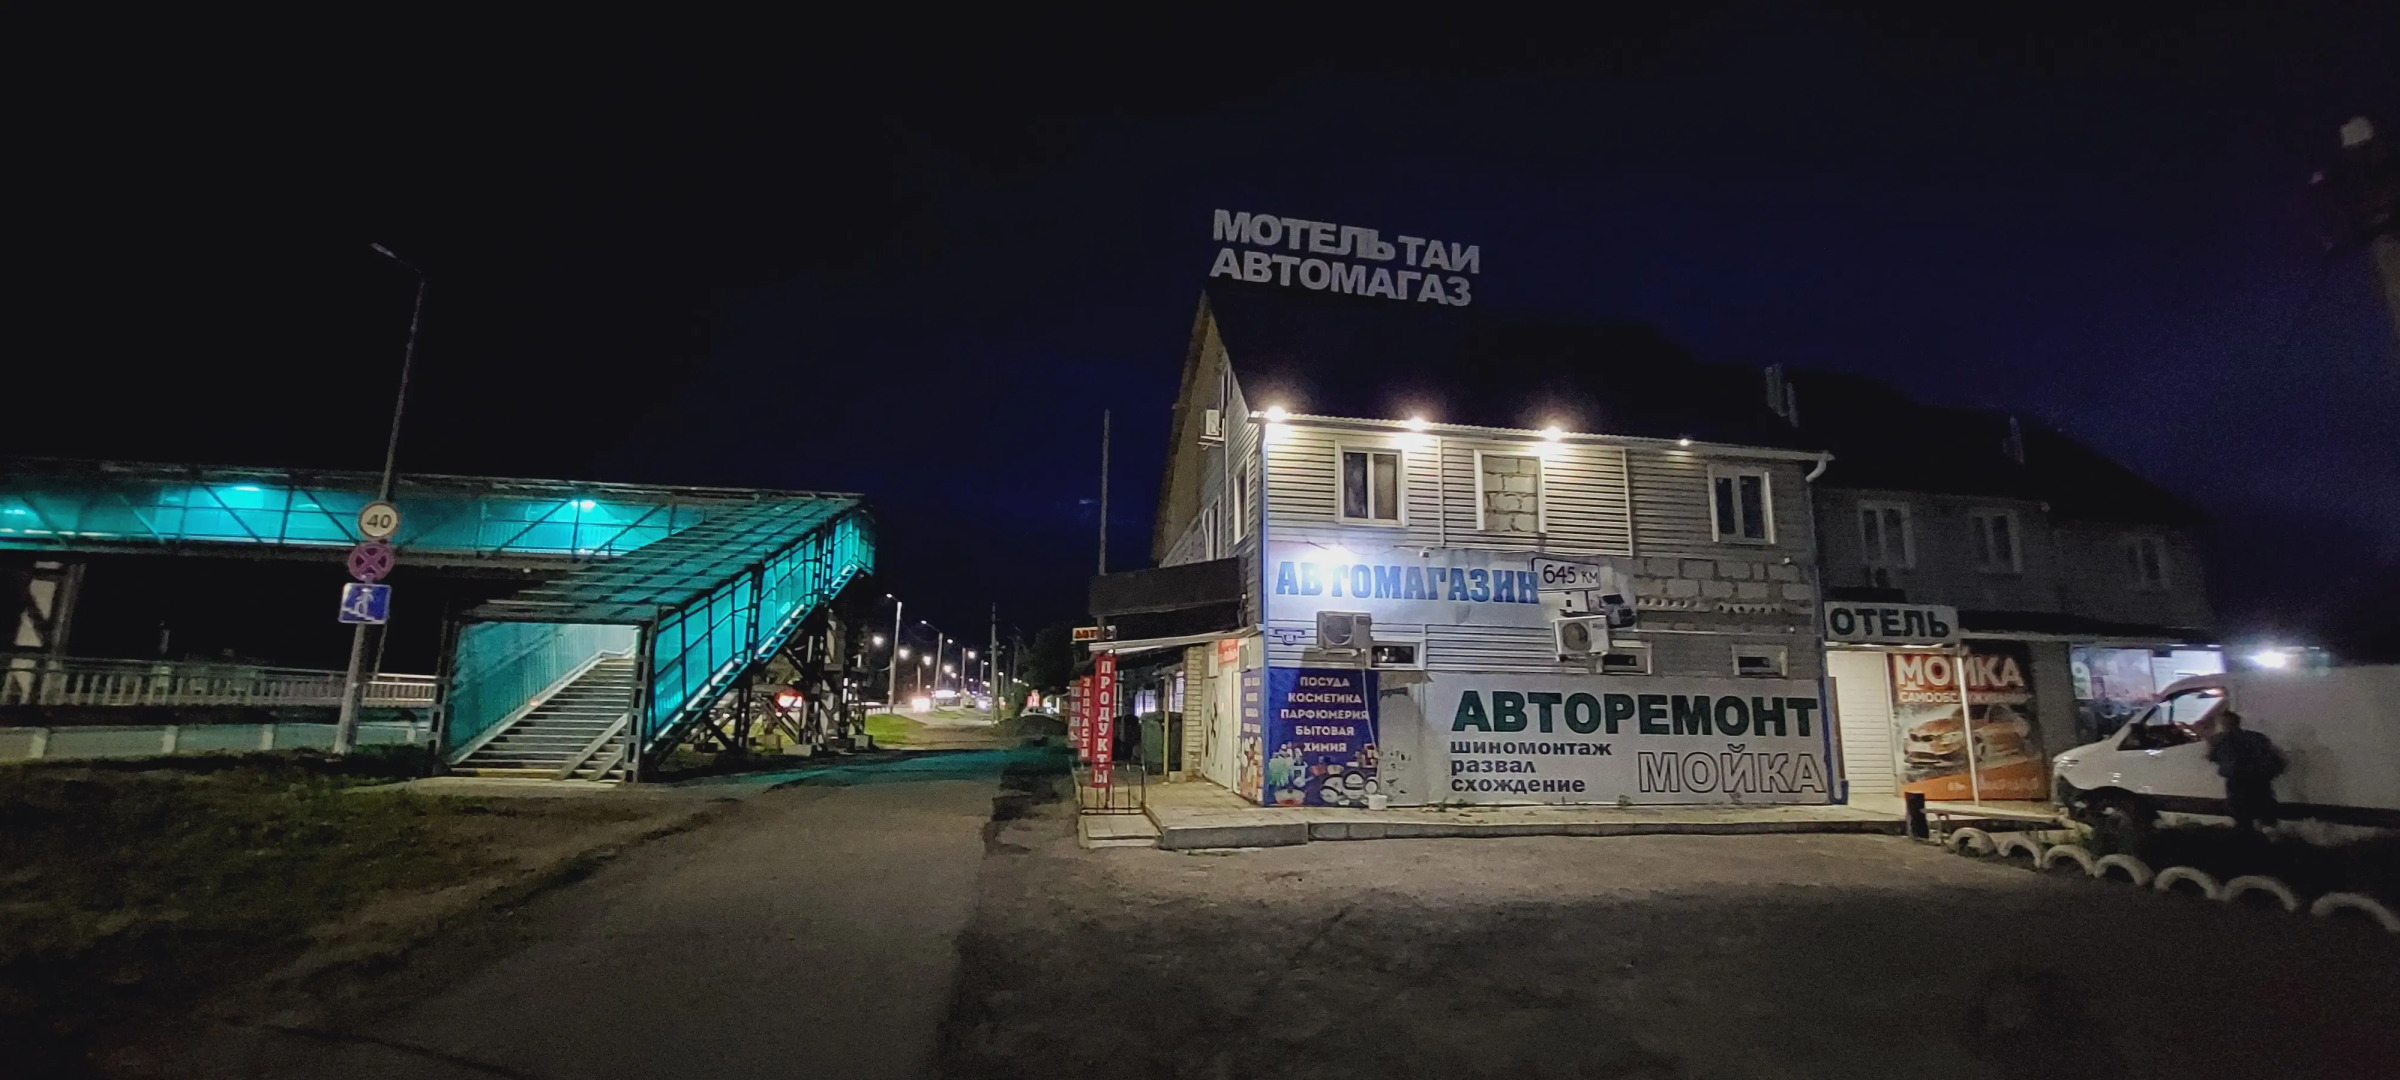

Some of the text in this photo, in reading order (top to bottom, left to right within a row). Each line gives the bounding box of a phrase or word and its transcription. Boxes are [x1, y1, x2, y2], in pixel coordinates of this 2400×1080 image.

[1213, 208, 1396, 261] МОТЕЛЬ
[1209, 248, 1473, 307] АВТОМАГАЗ
[367, 514, 392, 528] 40
[1276, 560, 1540, 604] АВТОМАГАЗИН
[1543, 564, 1577, 584] 645
[1830, 607, 1950, 638] ОТЕЛЬ
[1299, 676, 1350, 688] ПОСУДА
[1287, 692, 1362, 704] КОСМЕТИКА
[1081, 677, 1091, 758] ЗАПЧАСТИ
[1094, 661, 1112, 784] ПРОДУКТЫ
[1280, 708, 1369, 720] ПАРФЮМЕРИЯ
[1451, 690, 1819, 736] АВТОРЕМОНТ
[1295, 725, 1355, 737] БЫТОВАЯ
[1303, 742, 1347, 753] ХИМИЯ
[1450, 739, 1612, 756] шиномонтаж
[1451, 758, 1536, 777] развал
[1638, 743, 1827, 794] МОЙКА
[1451, 776, 1586, 794] схождение
